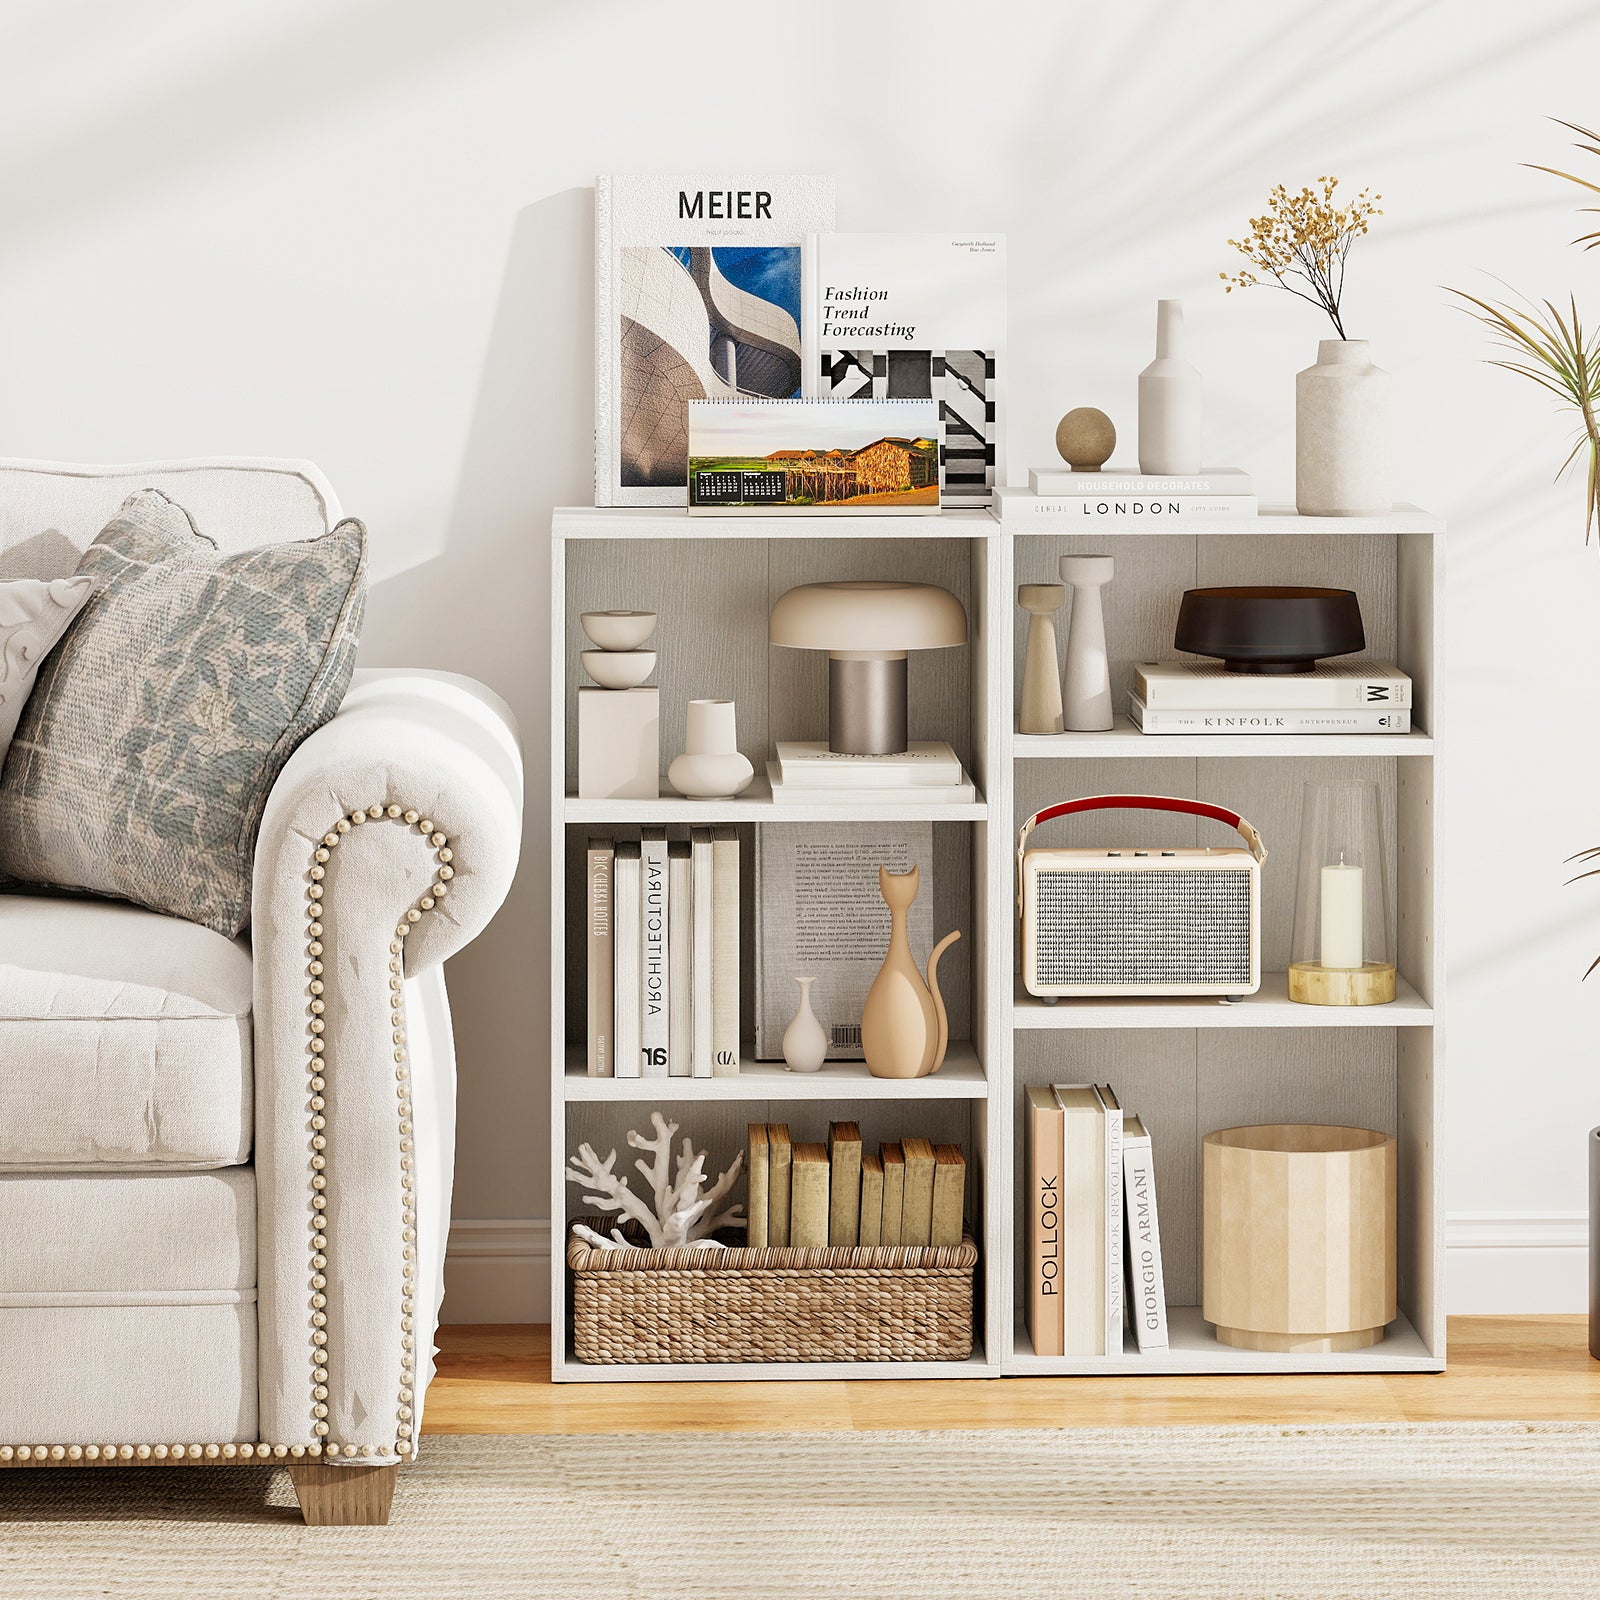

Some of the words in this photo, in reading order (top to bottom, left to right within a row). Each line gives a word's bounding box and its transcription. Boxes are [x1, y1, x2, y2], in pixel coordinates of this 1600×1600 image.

[678, 191, 772, 219] MEIER
[825, 286, 889, 301] Fashion
[823, 306, 869, 319] Trend
[822, 322, 916, 341] Forecasting
[1077, 480, 1143, 491] HOUSEHOLD
[1147, 480, 1210, 491] DECORATES
[1083, 502, 1181, 515] LONDON
[1367, 685, 1389, 702] M
[1203, 717, 1286, 727] KINFOLK
[1111, 1117, 1120, 1217] REVOLUTION
[1133, 1167, 1152, 1243] ARMANI
[1041, 1175, 1059, 1296] POLLOCK
[1111, 1223, 1120, 1265] LOOK
[1140, 1249, 1159, 1331] GIORGIO
